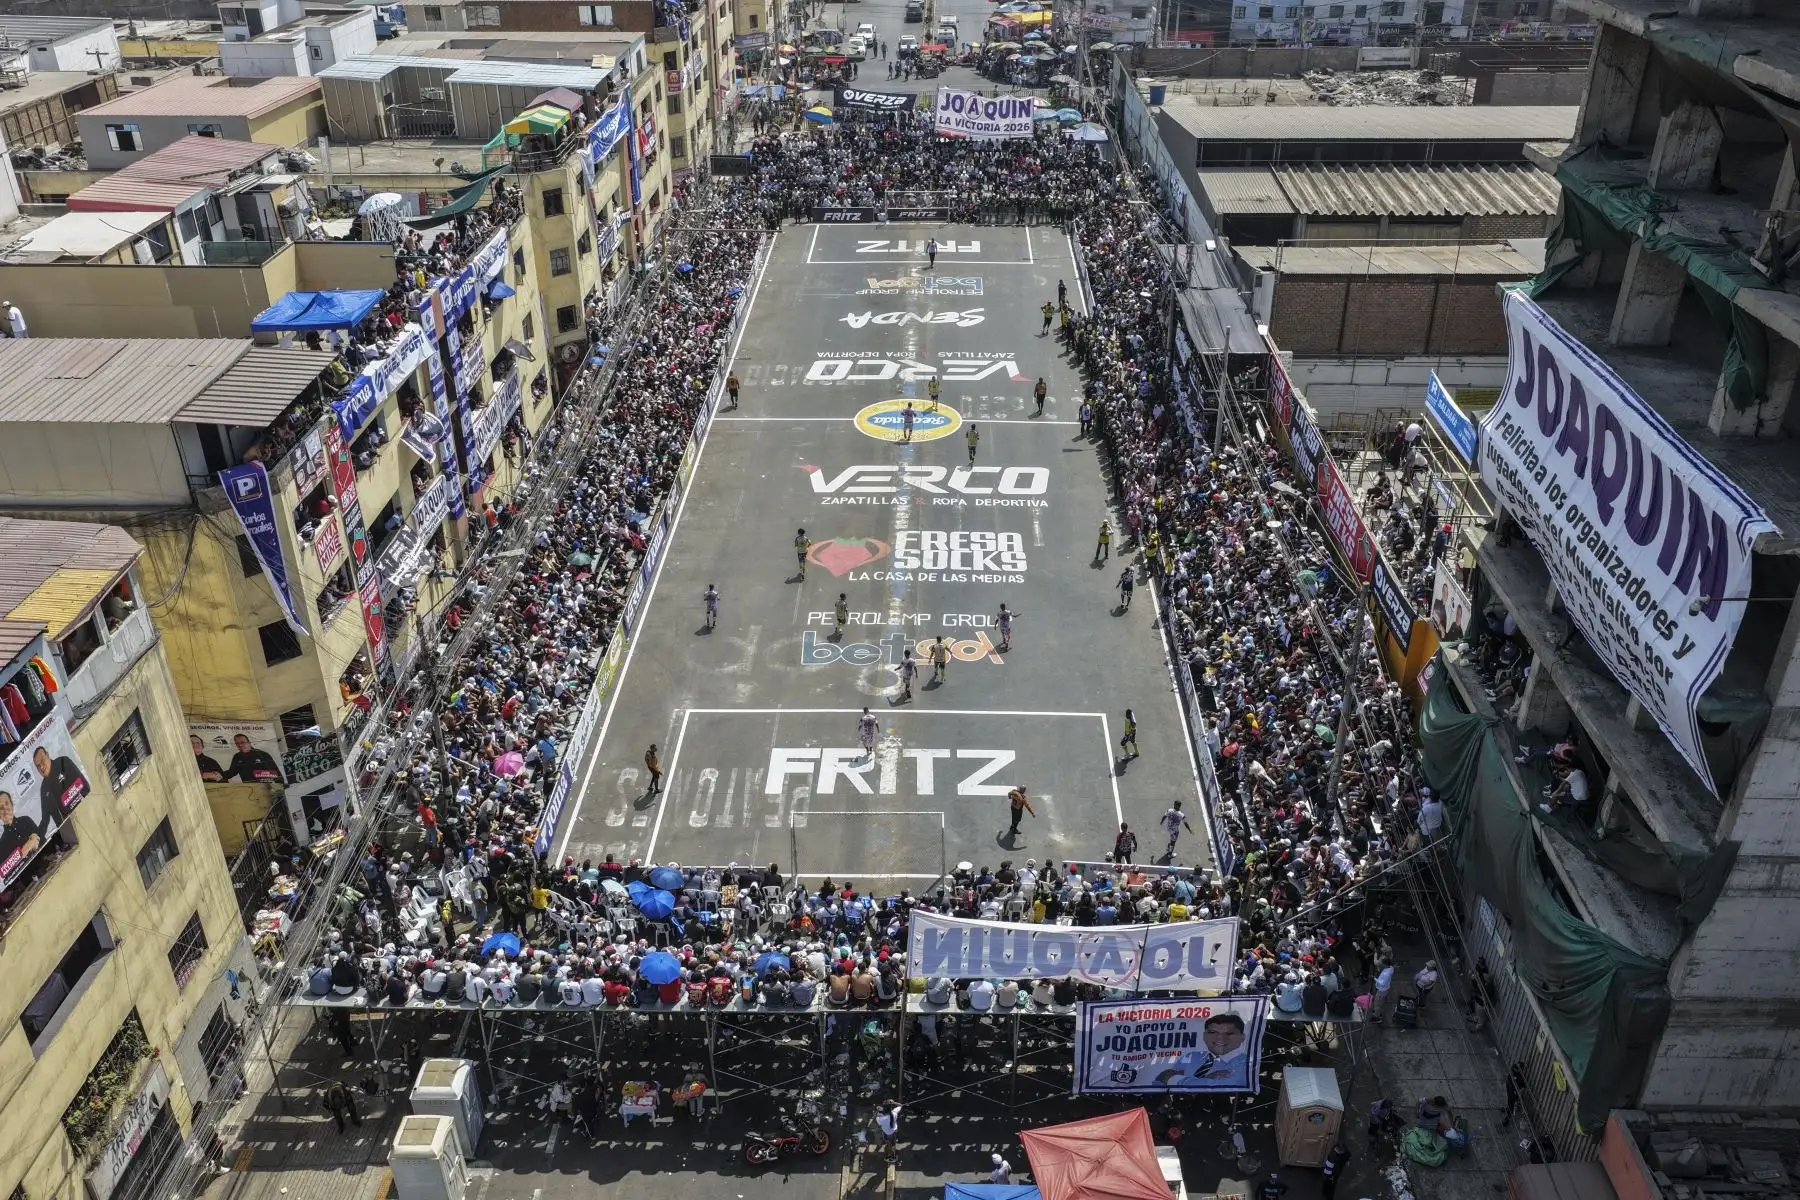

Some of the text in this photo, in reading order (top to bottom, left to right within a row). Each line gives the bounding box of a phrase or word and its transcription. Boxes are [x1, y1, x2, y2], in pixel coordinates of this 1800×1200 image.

[940, 93, 1031, 120] JOAQUIN
[938, 116, 1031, 134] LA VICTORIA 2026
[823, 211, 861, 221] FRITZ
[898, 209, 938, 218] FRITZ
[856, 240, 981, 253] FRITZ
[839, 308, 985, 328] SENDA
[806, 360, 1021, 381] VERCO
[809, 465, 1050, 494] VERCO
[1515, 326, 1729, 622] JOAQUIN
[237, 478, 255, 497] P
[415, 485, 445, 528] JOAQUIN
[821, 496, 908, 505] ZAPATILLAS
[932, 498, 968, 506] ROPA
[975, 499, 1048, 507] DEPORTIVA
[240, 511, 266, 525] Carlos
[1326, 501, 1356, 557] SOCKS
[1495, 412, 1540, 473] Felicita
[1534, 465, 1548, 486] a
[1544, 473, 1568, 511] los
[1566, 504, 1680, 643] organizadores
[1671, 633, 1697, 660] y
[896, 531, 1023, 552] FRESA
[894, 549, 1028, 571] SOCKS
[1486, 437, 1675, 687] jugadores del Mundialito por
[849, 572, 1025, 583] LA CASA DE LAS MEDIAS
[807, 612, 1013, 627] PEROLEMP GROU
[20, 738, 35, 754] VIVIR
[765, 748, 1016, 796] FRITZ
[1098, 1006, 1211, 1023] LA VICTORIA 2026
[1115, 1021, 1187, 1034] YO APOYO A
[1096, 1031, 1197, 1054] JOAQUIN
[1122, 1053, 1147, 1062] AMIGO
[1155, 1051, 1182, 1059] VECINO
[110, 1094, 147, 1156] TRIUNFO
